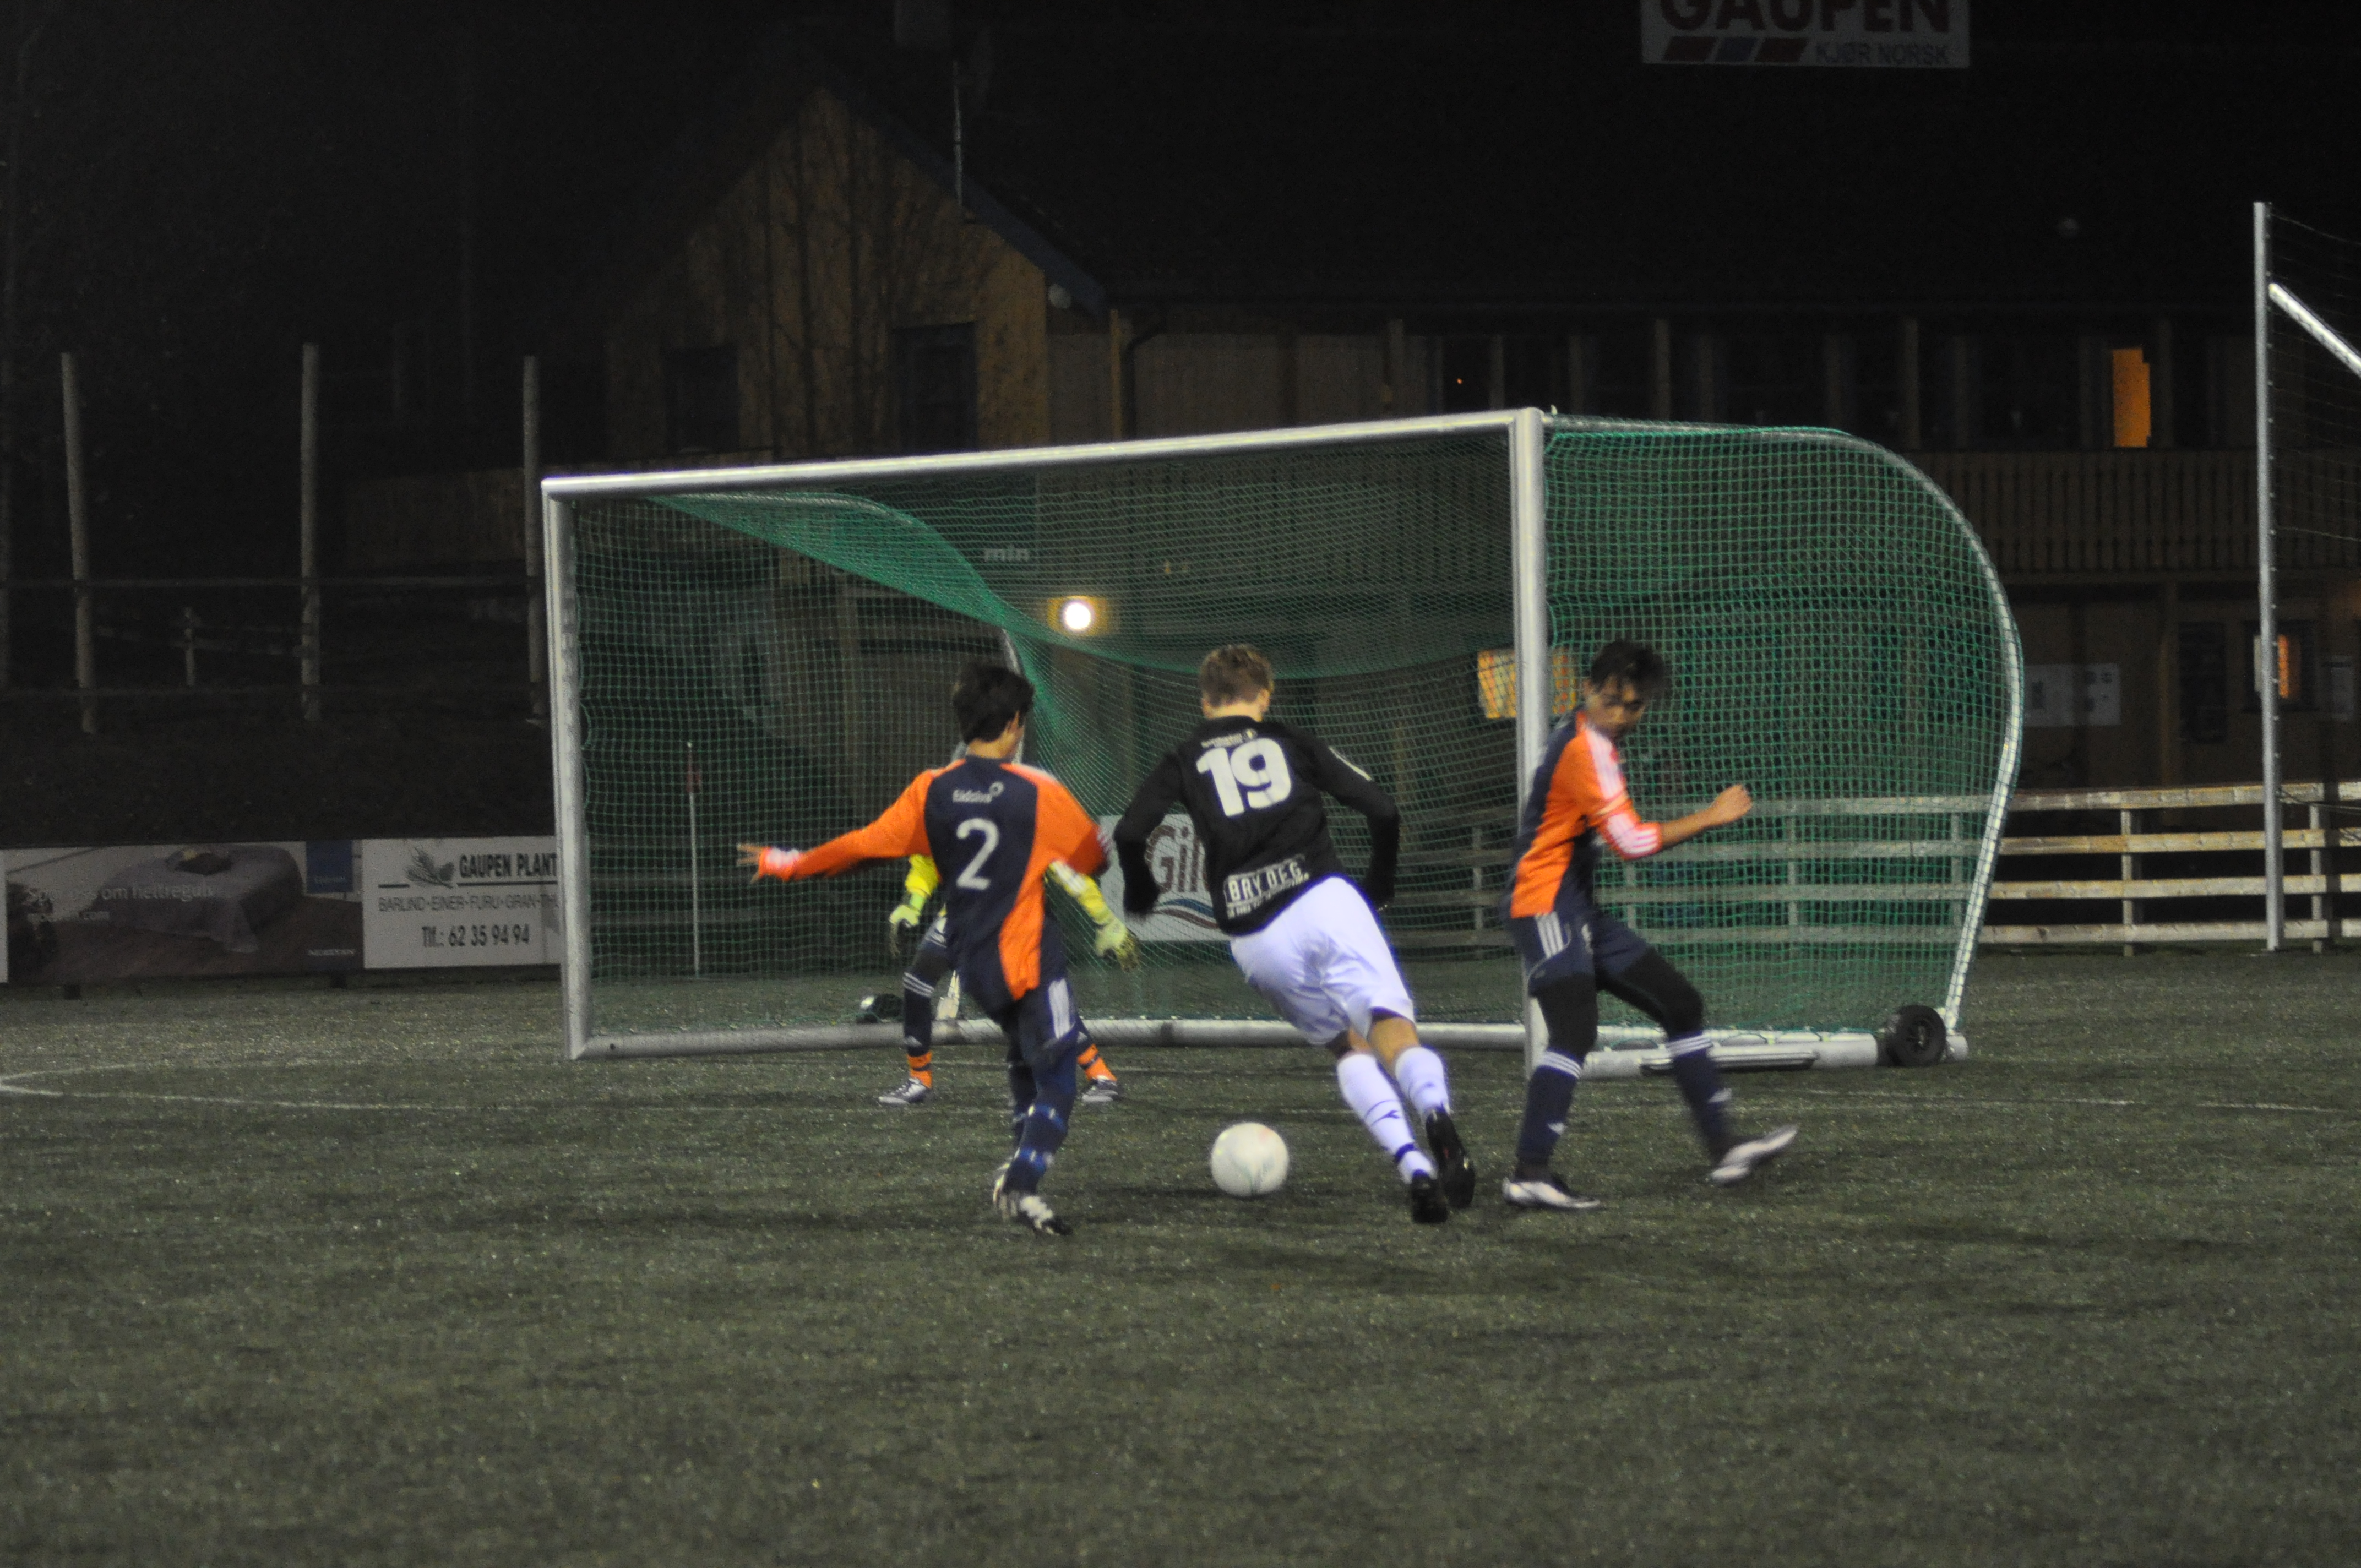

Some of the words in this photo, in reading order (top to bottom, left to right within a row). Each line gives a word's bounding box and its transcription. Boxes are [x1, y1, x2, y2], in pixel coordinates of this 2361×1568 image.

[1661, 0, 1950, 32] GAUPEN
[1878, 44, 1948, 65] NORSK
[1196, 738, 1291, 817] 19
[459, 854, 511, 878] GAUPEN
[956, 818, 999, 890] 2
[1144, 825, 1209, 893] Gil
[102, 887, 128, 900] om
[449, 925, 465, 947] 62
[471, 925, 487, 946] 35
[492, 924, 508, 945] 94
[512, 923, 530, 945] 94
